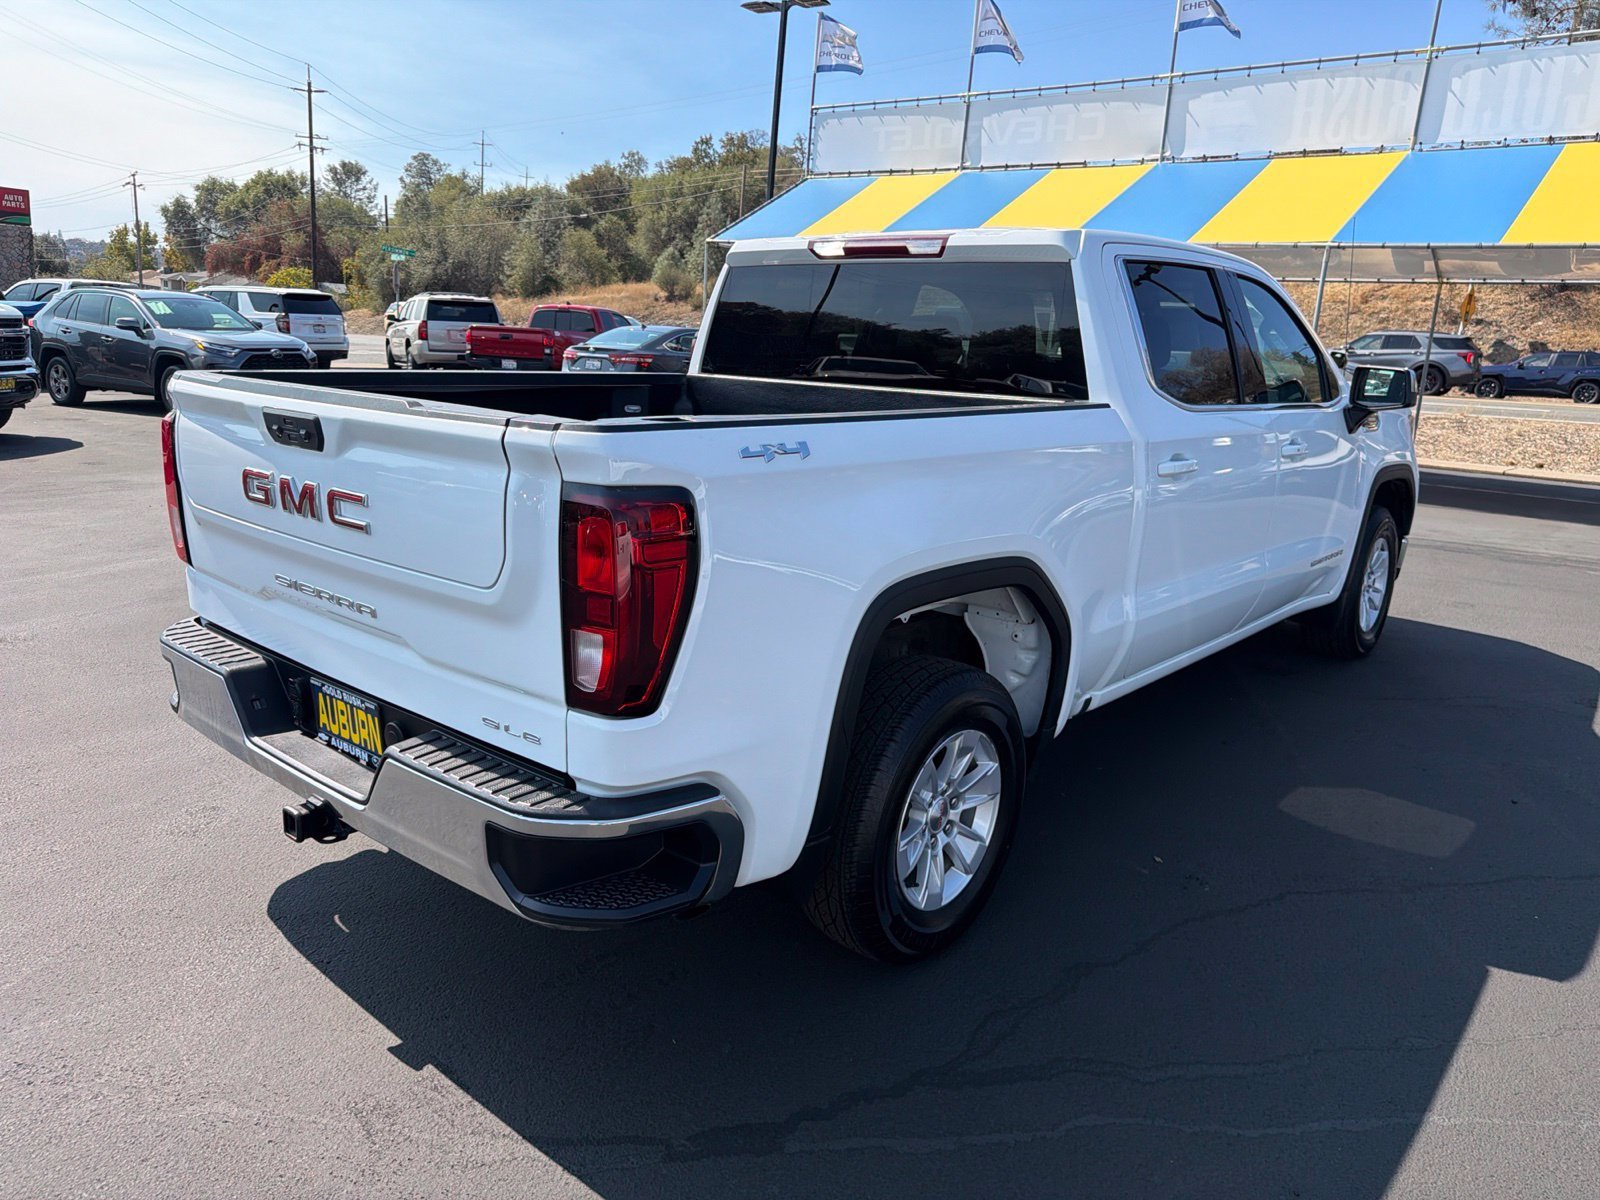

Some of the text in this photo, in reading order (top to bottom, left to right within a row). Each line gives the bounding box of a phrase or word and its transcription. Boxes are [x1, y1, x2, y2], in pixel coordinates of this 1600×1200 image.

[2, 200, 25, 209] PARTS
[4, 193, 23, 202] AUTO
[242, 466, 372, 536] GMC
[274, 573, 378, 619] SIERRA
[318, 692, 383, 756] AUBURN
[481, 716, 542, 746] SLE
[330, 737, 369, 763] AUBURN
